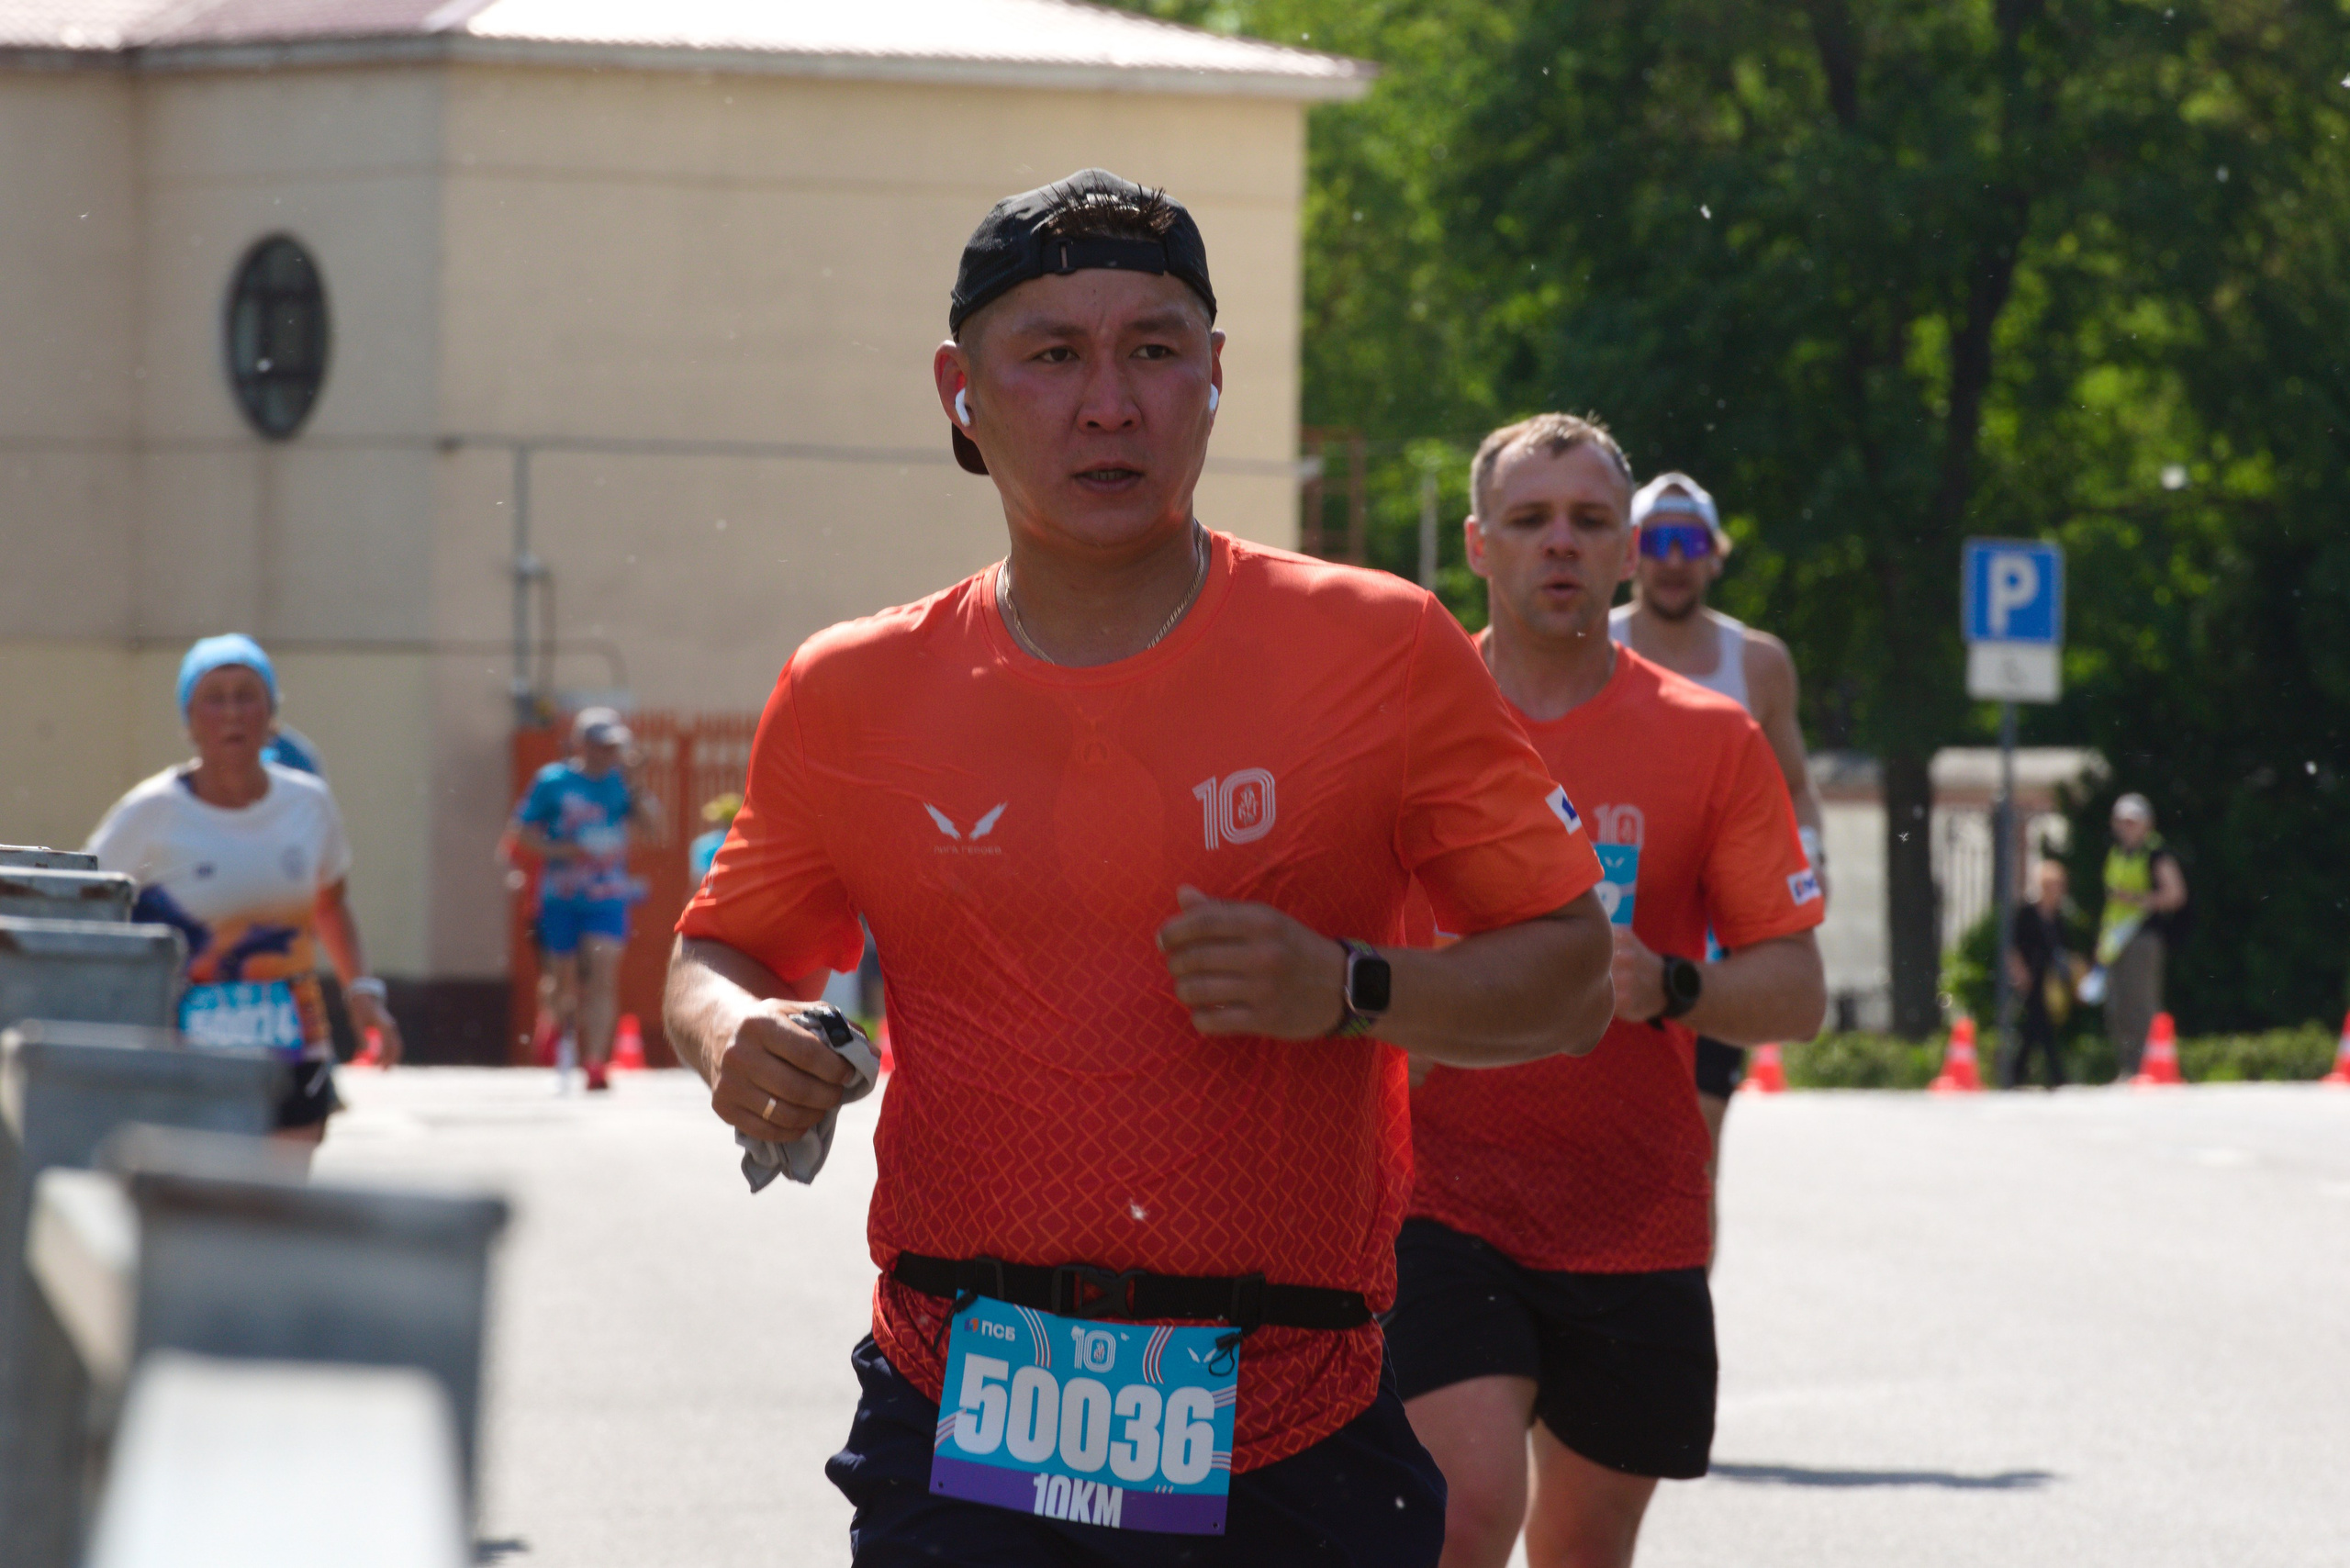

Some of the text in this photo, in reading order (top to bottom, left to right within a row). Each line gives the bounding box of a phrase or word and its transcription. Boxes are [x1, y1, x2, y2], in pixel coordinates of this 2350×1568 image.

[1986, 553, 2040, 633] P
[1192, 767, 1276, 851] 10
[1594, 803, 1644, 852] 10
[981, 1324, 1015, 1341] ПСБ
[1070, 1325, 1117, 1373] 10
[953, 1352, 1215, 1485] 50036
